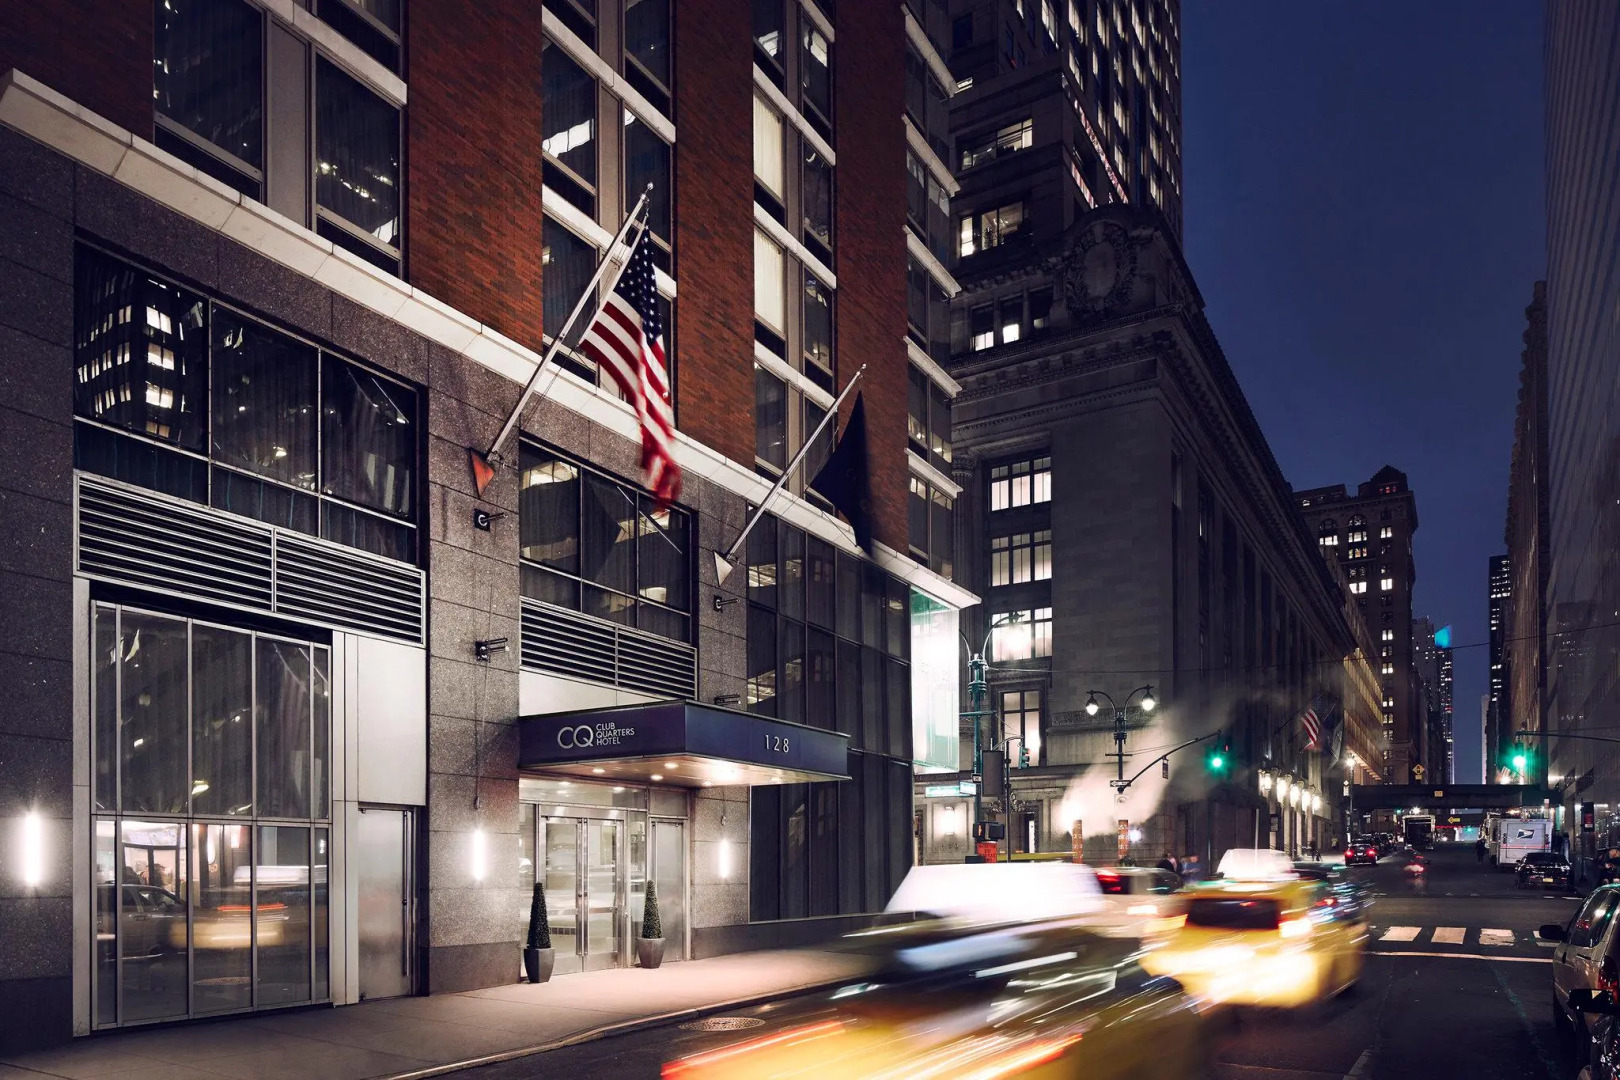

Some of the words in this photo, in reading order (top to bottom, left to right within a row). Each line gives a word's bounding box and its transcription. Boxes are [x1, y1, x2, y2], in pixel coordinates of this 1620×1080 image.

[596, 722, 615, 731] CLUB
[557, 725, 594, 749] CQ
[596, 728, 635, 738] QUARTERS
[596, 737, 620, 746] HOTEL
[765, 734, 789, 753] 128
